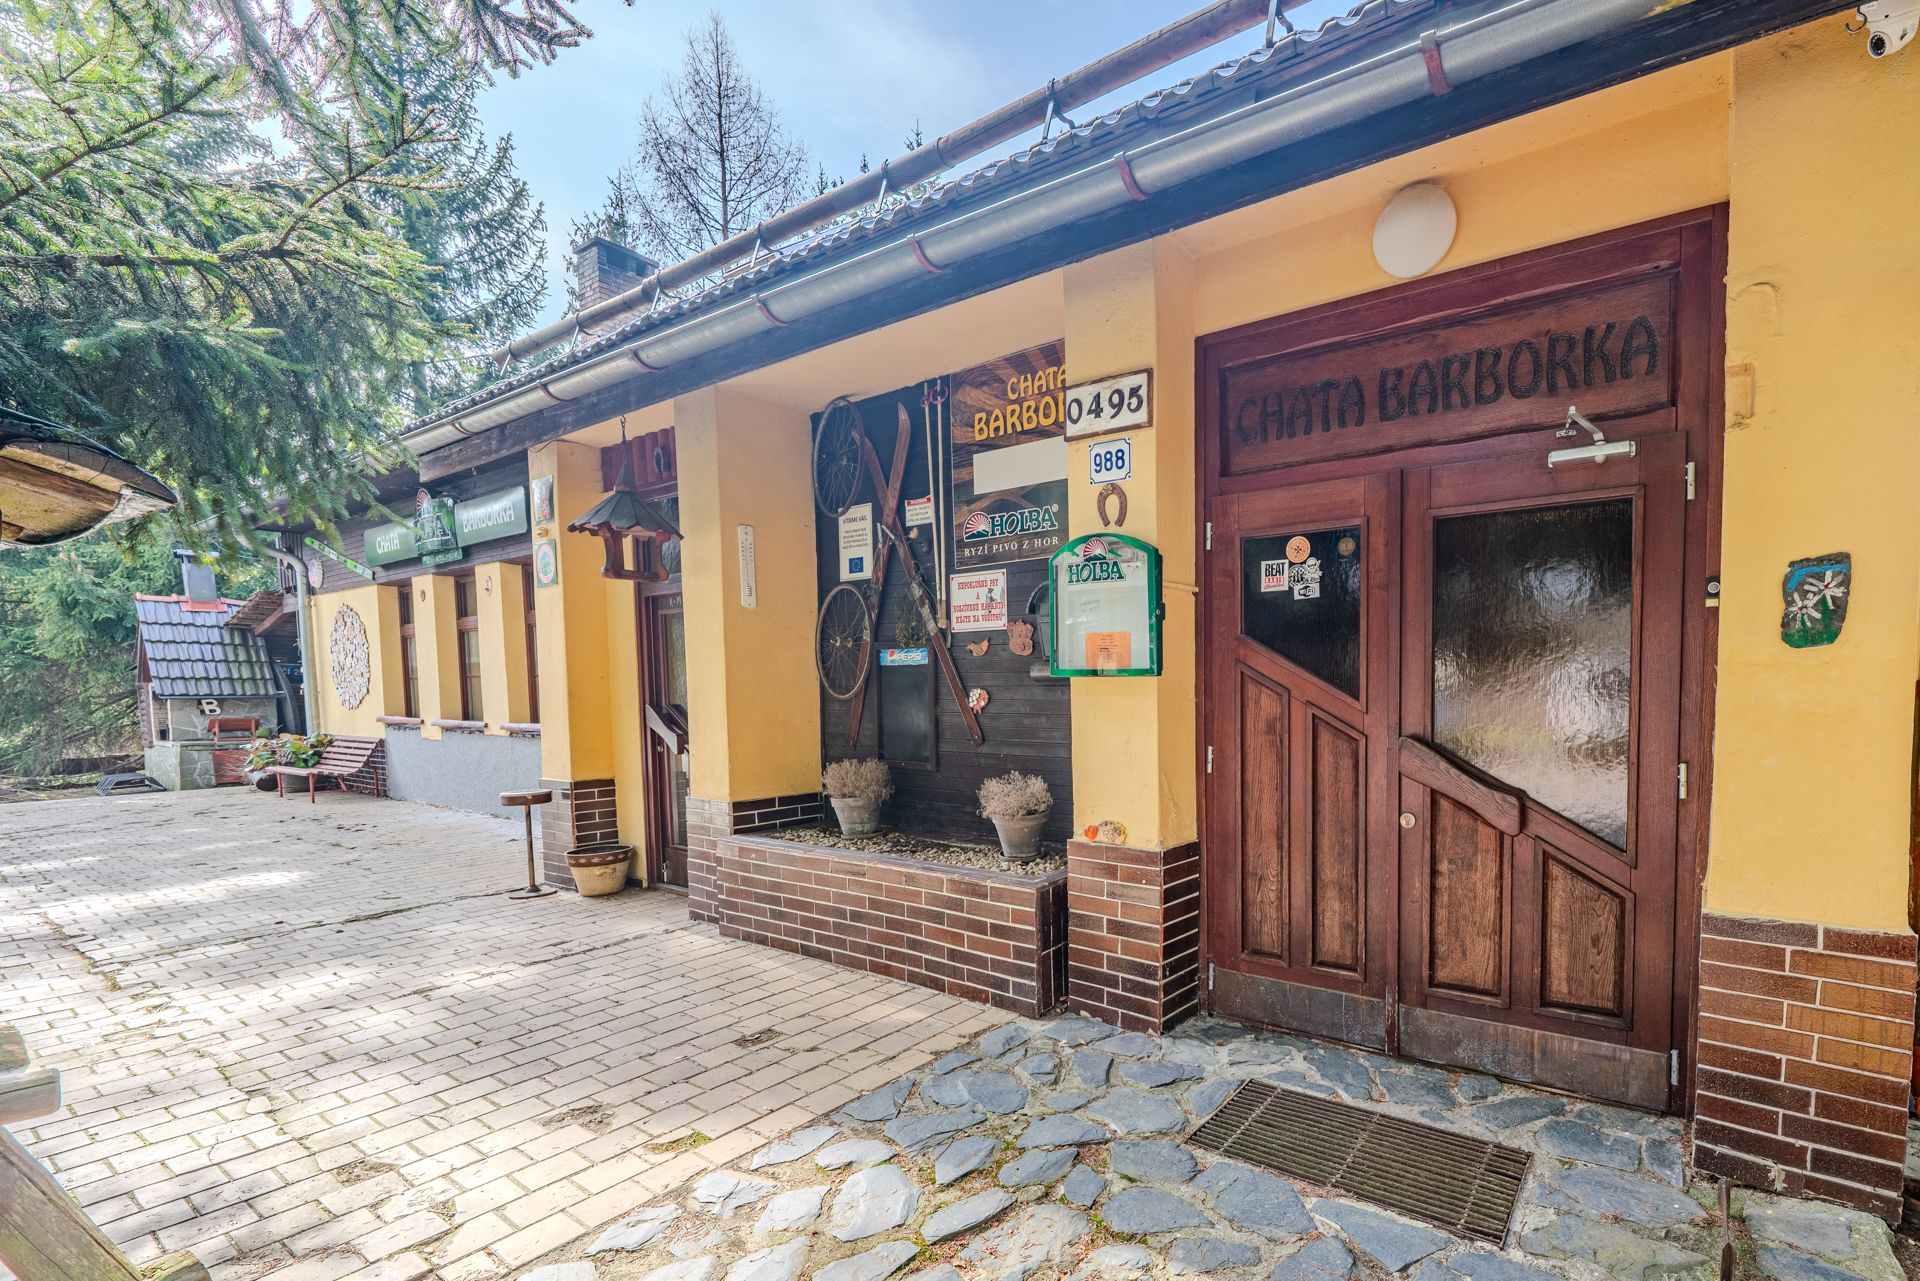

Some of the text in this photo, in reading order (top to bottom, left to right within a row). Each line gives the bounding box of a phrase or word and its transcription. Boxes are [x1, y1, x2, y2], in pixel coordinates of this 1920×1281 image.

[1235, 315, 1659, 445] CHATA BARBORKA
[1067, 384, 1144, 425] 0495
[1093, 448, 1126, 474] 988
[375, 531, 400, 554] CHATA
[462, 501, 515, 532] BARBORKA
[989, 505, 1058, 538] HOLBA
[964, 536, 1059, 557] RYZÍ PIVO Z HOR
[1066, 560, 1126, 585] HOLBA
[1264, 562, 1286, 577] BEAT
[989, 578, 999, 588] PSY
[972, 614, 980, 623] NA
[896, 652, 922, 661] PEPSI
[200, 699, 221, 715] B
